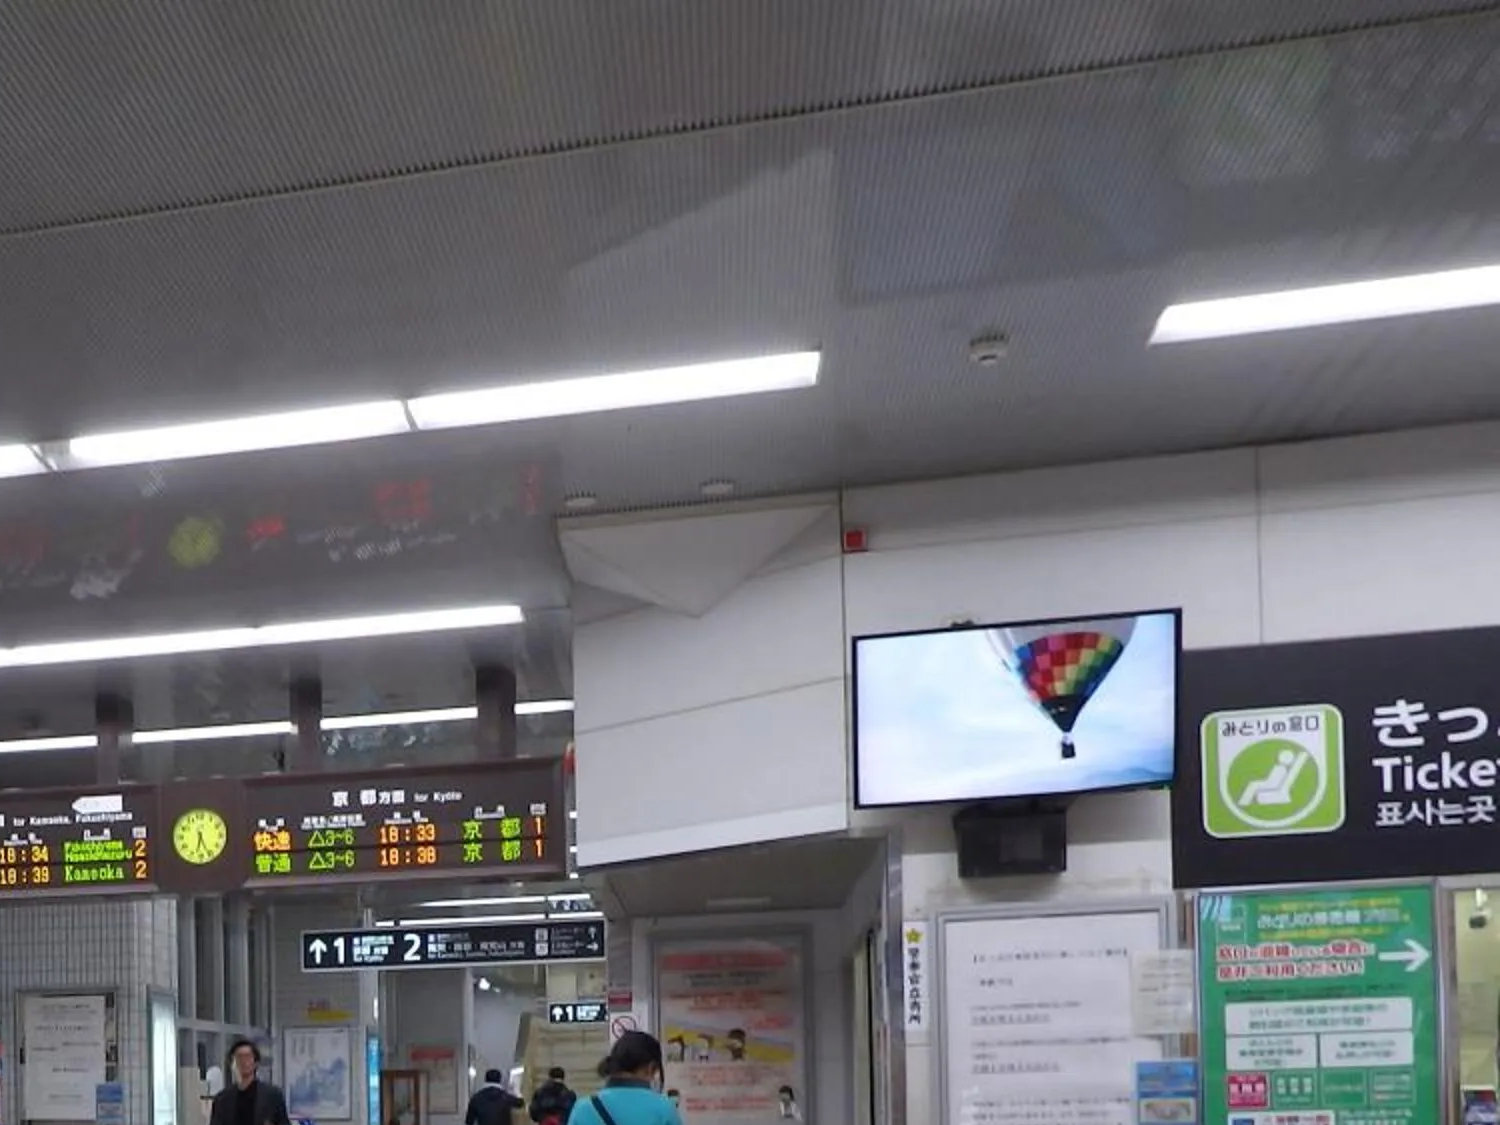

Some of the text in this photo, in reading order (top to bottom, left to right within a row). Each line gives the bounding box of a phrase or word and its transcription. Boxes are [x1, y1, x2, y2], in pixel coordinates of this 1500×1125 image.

[1221, 715, 1320, 737] みどりの窓口
[1372, 699, 1500, 747] きっ
[1372, 751, 1500, 793] Ticke
[1375, 795, 1496, 827] 표사는곳
[534, 817, 542, 834] 1
[134, 840, 146, 857] 2
[255, 853, 292, 874] 普通
[535, 840, 543, 858] 1
[135, 861, 147, 879] 2
[333, 937, 345, 964] 1
[403, 933, 421, 961] 2
[565, 1005, 574, 1021] 1
